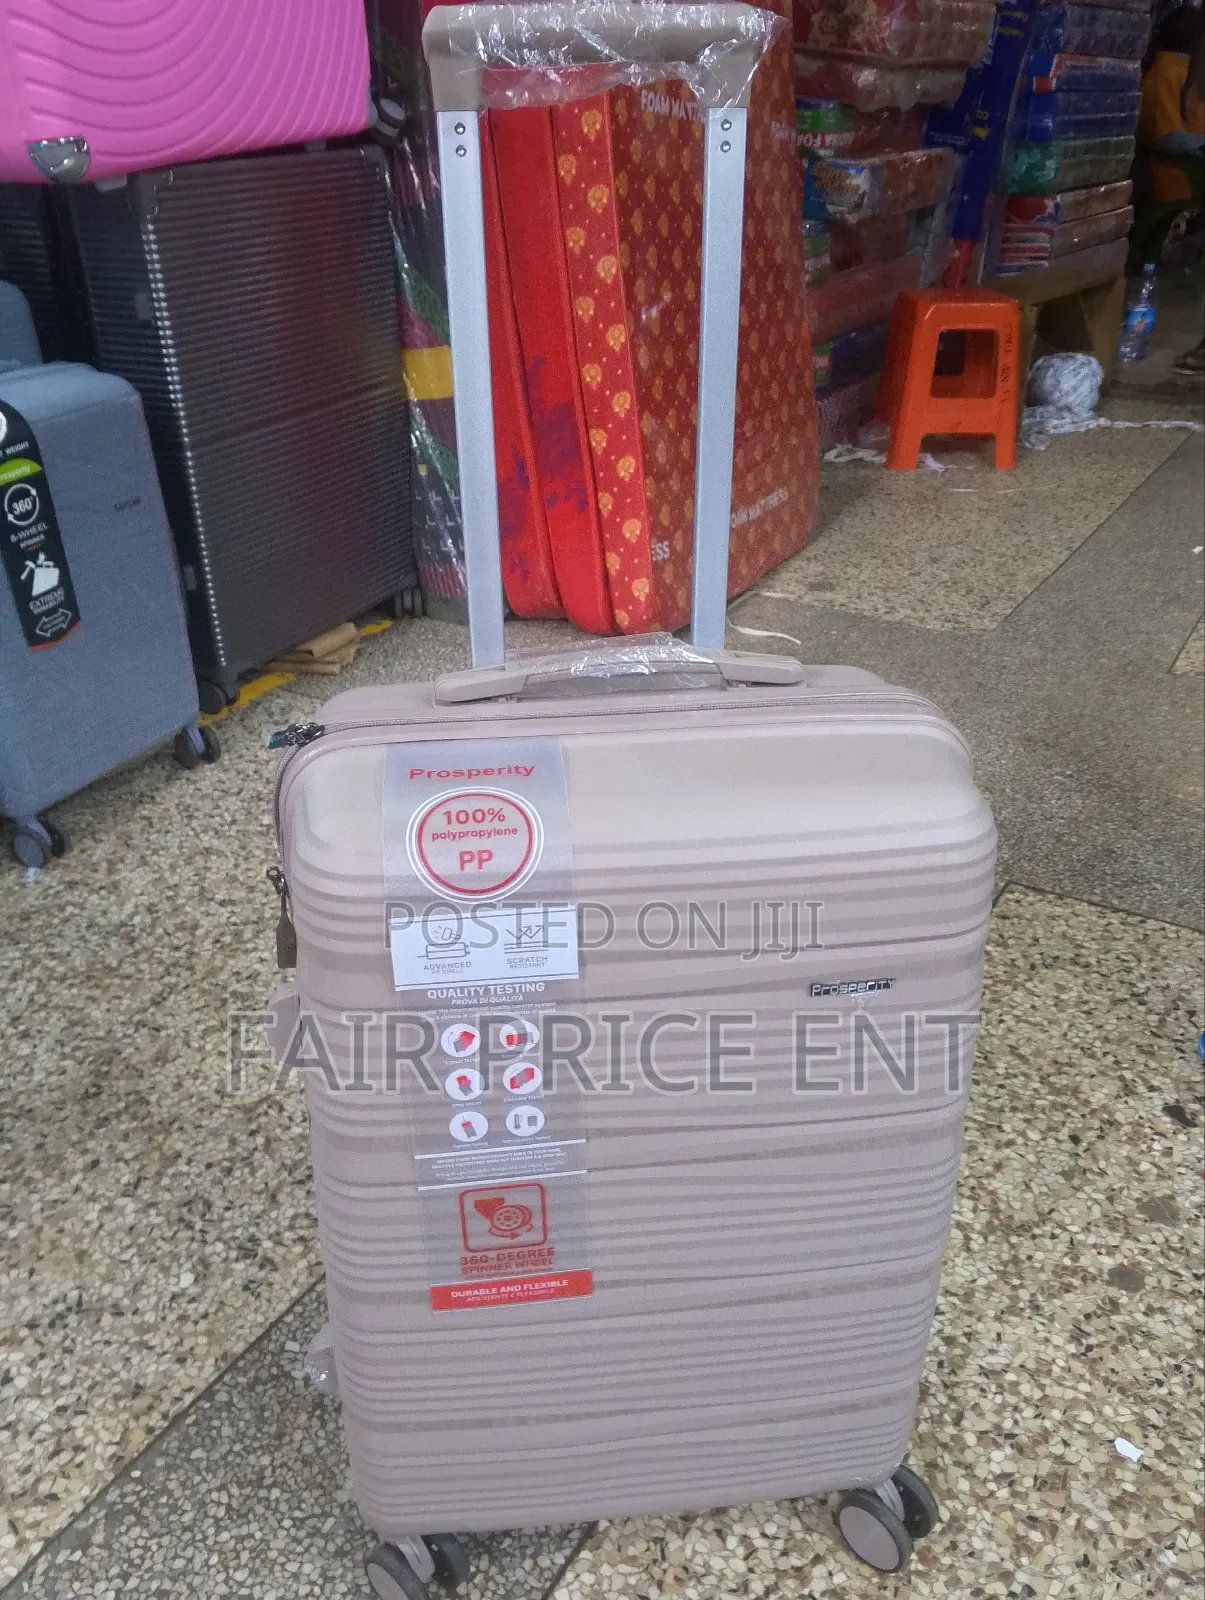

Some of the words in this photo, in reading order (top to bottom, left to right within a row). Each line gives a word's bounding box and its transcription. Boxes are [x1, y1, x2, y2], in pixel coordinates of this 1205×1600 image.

[641, 89, 670, 118] FOAM
[409, 764, 536, 780] Prosperity
[442, 808, 506, 826] 100%
[431, 827, 519, 842] polypropylene
[459, 849, 494, 871] PP
[423, 961, 472, 971] ADVANCED
[506, 956, 548, 965] SCRATCH
[509, 962, 546, 970] RESISTANT
[427, 986, 485, 999] QUALITY
[489, 982, 546, 995] TESTING
[450, 998, 479, 1006] PROVA
[489, 995, 524, 1004] QUALITÀ
[460, 1247, 555, 1266] 360-DEGREE
[461, 1261, 512, 1275] SPINNER
[515, 1258, 554, 1268] WHEEL
[450, 1287, 498, 1298] DURABLE
[499, 1285, 522, 1293] AND
[523, 1279, 569, 1290] FLEXIBLE
